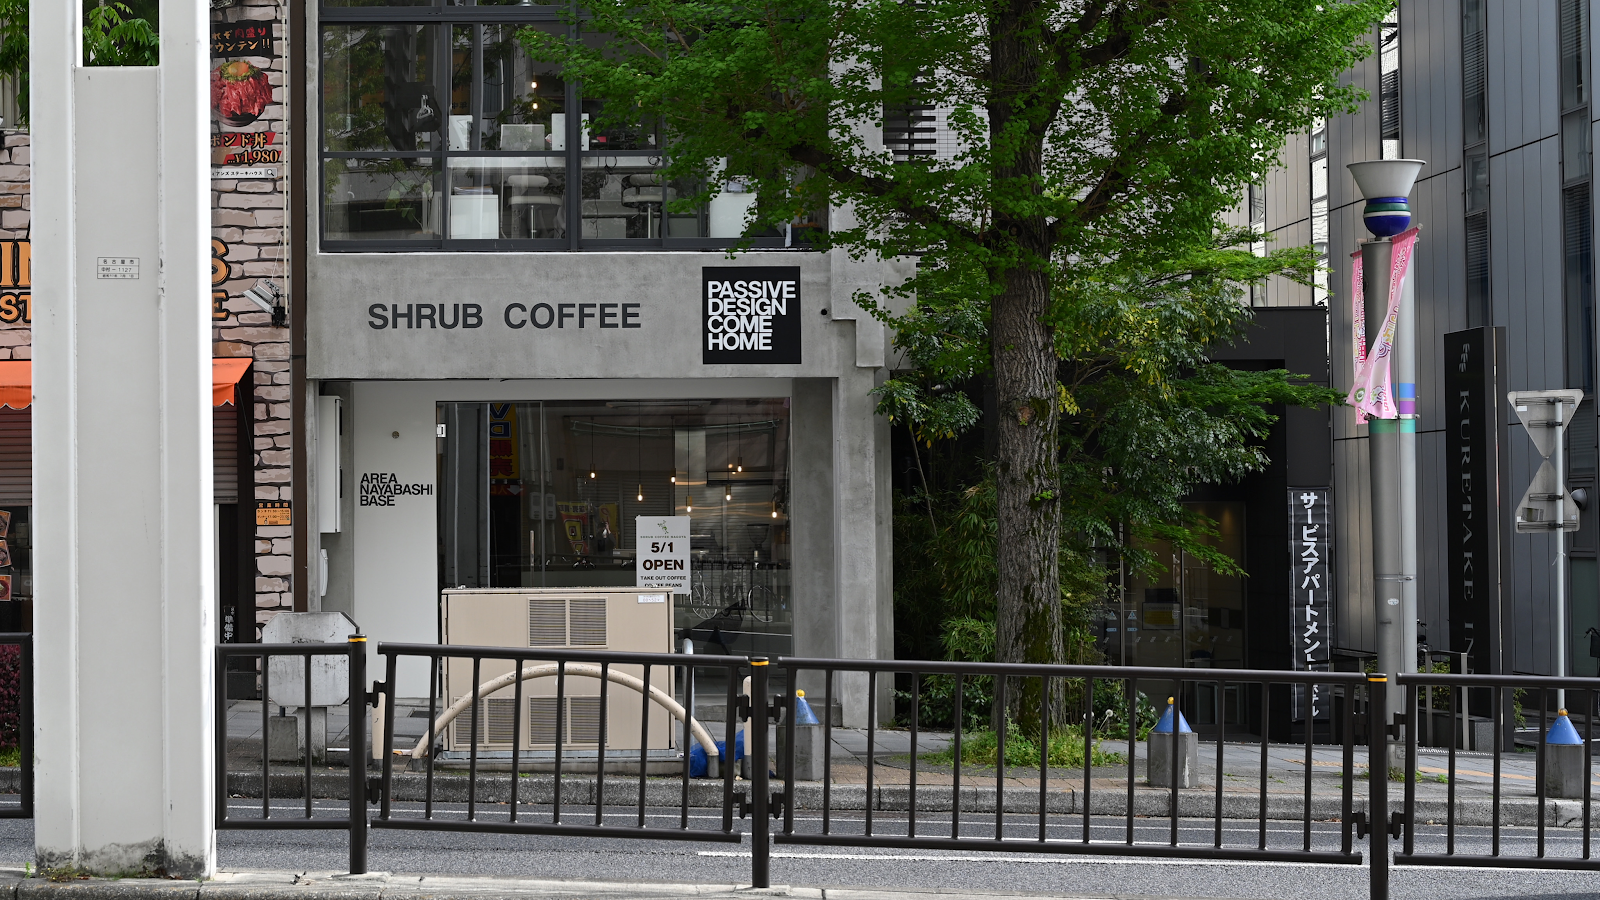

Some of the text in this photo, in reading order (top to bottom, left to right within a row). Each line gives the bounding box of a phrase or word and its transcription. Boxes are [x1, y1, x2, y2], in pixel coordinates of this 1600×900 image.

[708, 280, 796, 298] PASSIVE
[708, 298, 786, 315] DESIGN
[368, 303, 641, 329] SHRUB COFFEE
[708, 315, 773, 333] COME
[708, 332, 772, 350] HOME
[360, 473, 398, 484] AREA
[360, 484, 433, 495] NAYABASHI
[1460, 389, 1475, 601] KURETAKE
[360, 495, 396, 506] BASE
[651, 542, 673, 553] 5/1
[643, 559, 684, 570] OPEN
